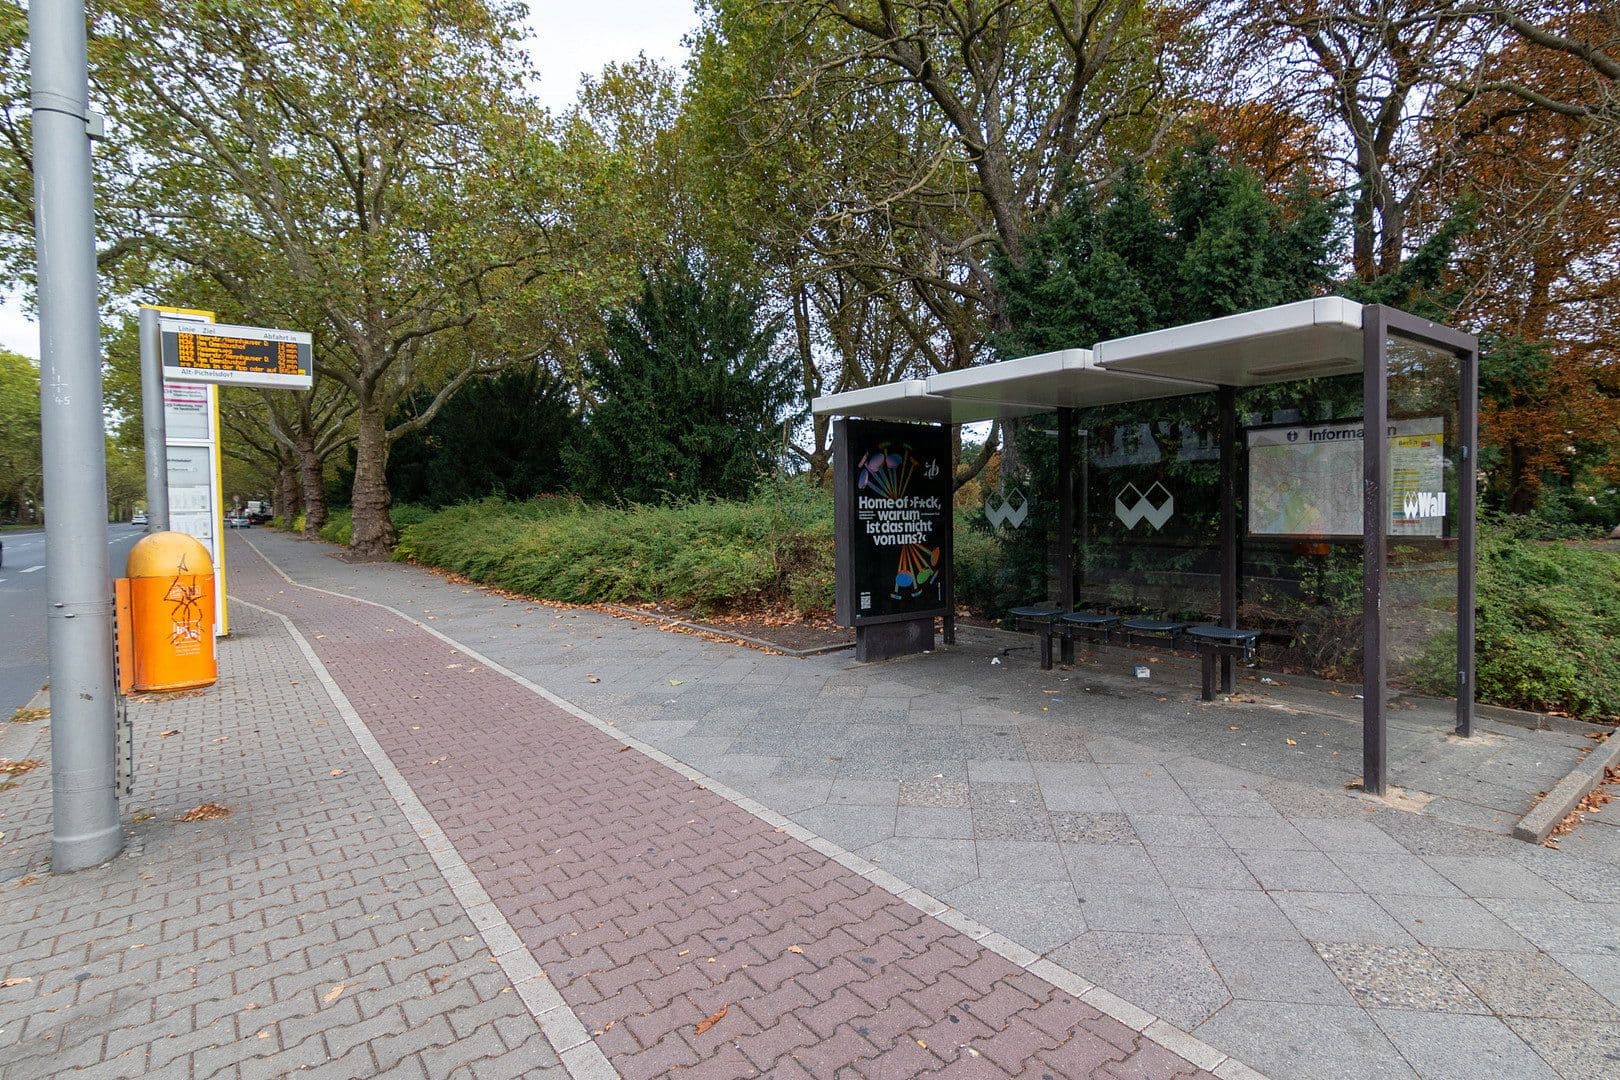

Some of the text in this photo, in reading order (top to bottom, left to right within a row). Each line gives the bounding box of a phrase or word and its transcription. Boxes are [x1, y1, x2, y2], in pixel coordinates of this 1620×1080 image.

[182, 369, 233, 378] Alt-Pichelsdorf
[1309, 426, 1396, 441] Informan
[858, 496, 894, 509] Home
[896, 496, 909, 509] of
[1418, 492, 1446, 518] Wall
[878, 510, 920, 521] warum
[866, 520, 932, 533] ist das nicht
[873, 534, 896, 545] von
